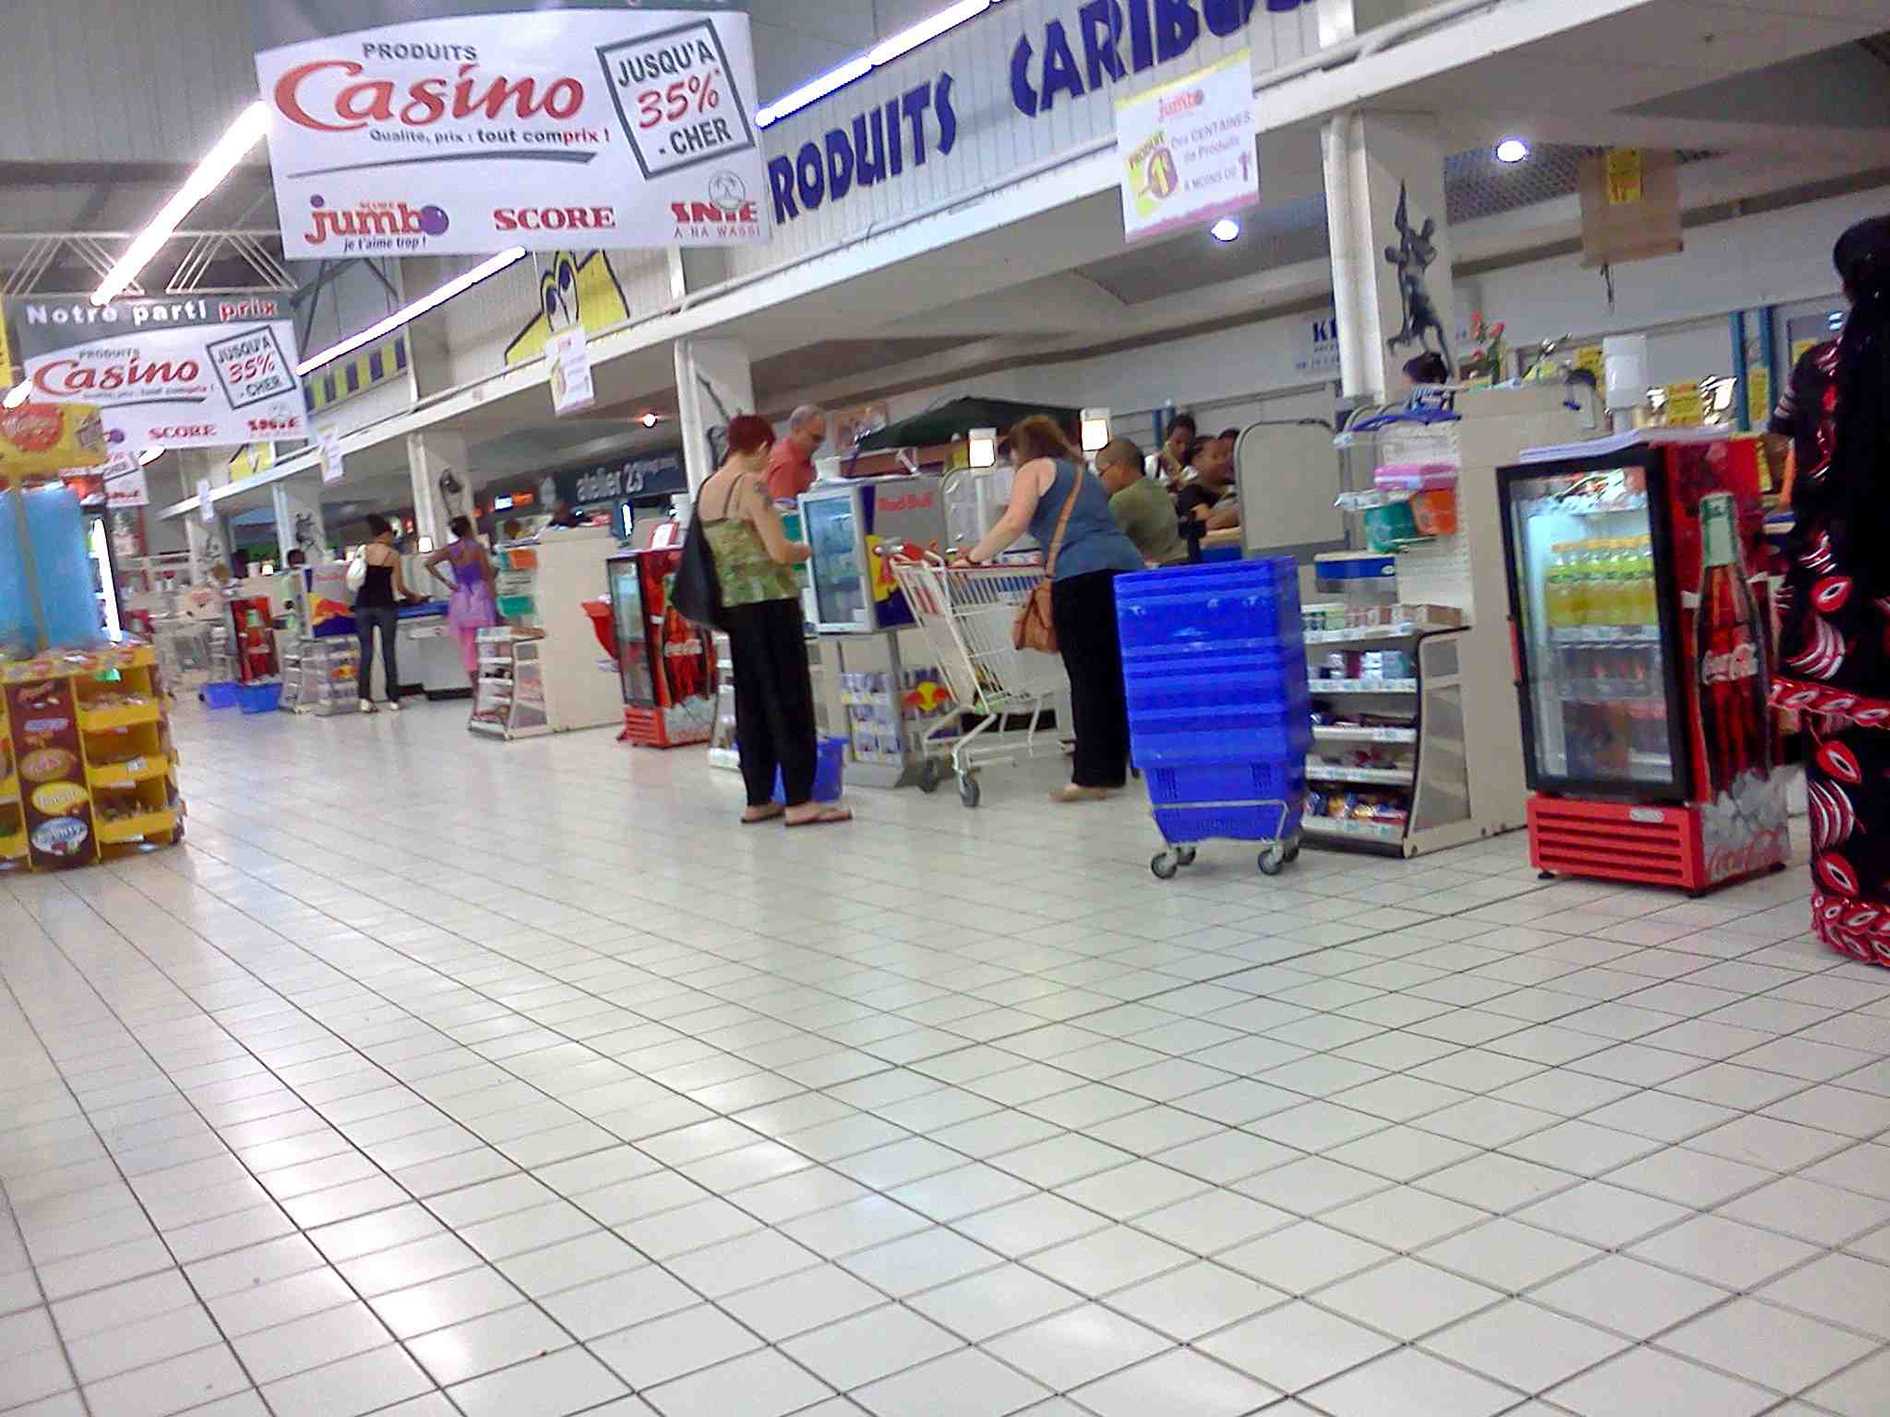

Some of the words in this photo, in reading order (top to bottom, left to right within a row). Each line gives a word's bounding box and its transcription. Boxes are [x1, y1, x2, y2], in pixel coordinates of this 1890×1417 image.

[362, 42, 478, 61] PRODUITS
[618, 39, 716, 87] JUSQU'A
[274, 60, 584, 132] Casino
[768, 71, 957, 225] RODUITS
[1011, 0, 1313, 118] CARIB
[478, 128, 516, 143] tout
[522, 128, 603, 146] comprix
[669, 118, 733, 155] CHER
[1191, 110, 1251, 144] CENTAINES
[304, 194, 450, 245] jumbo
[493, 206, 616, 230] SCORE
[396, 236, 419, 249] trop
[26, 302, 118, 325] Notre
[33, 357, 199, 396] Casino
